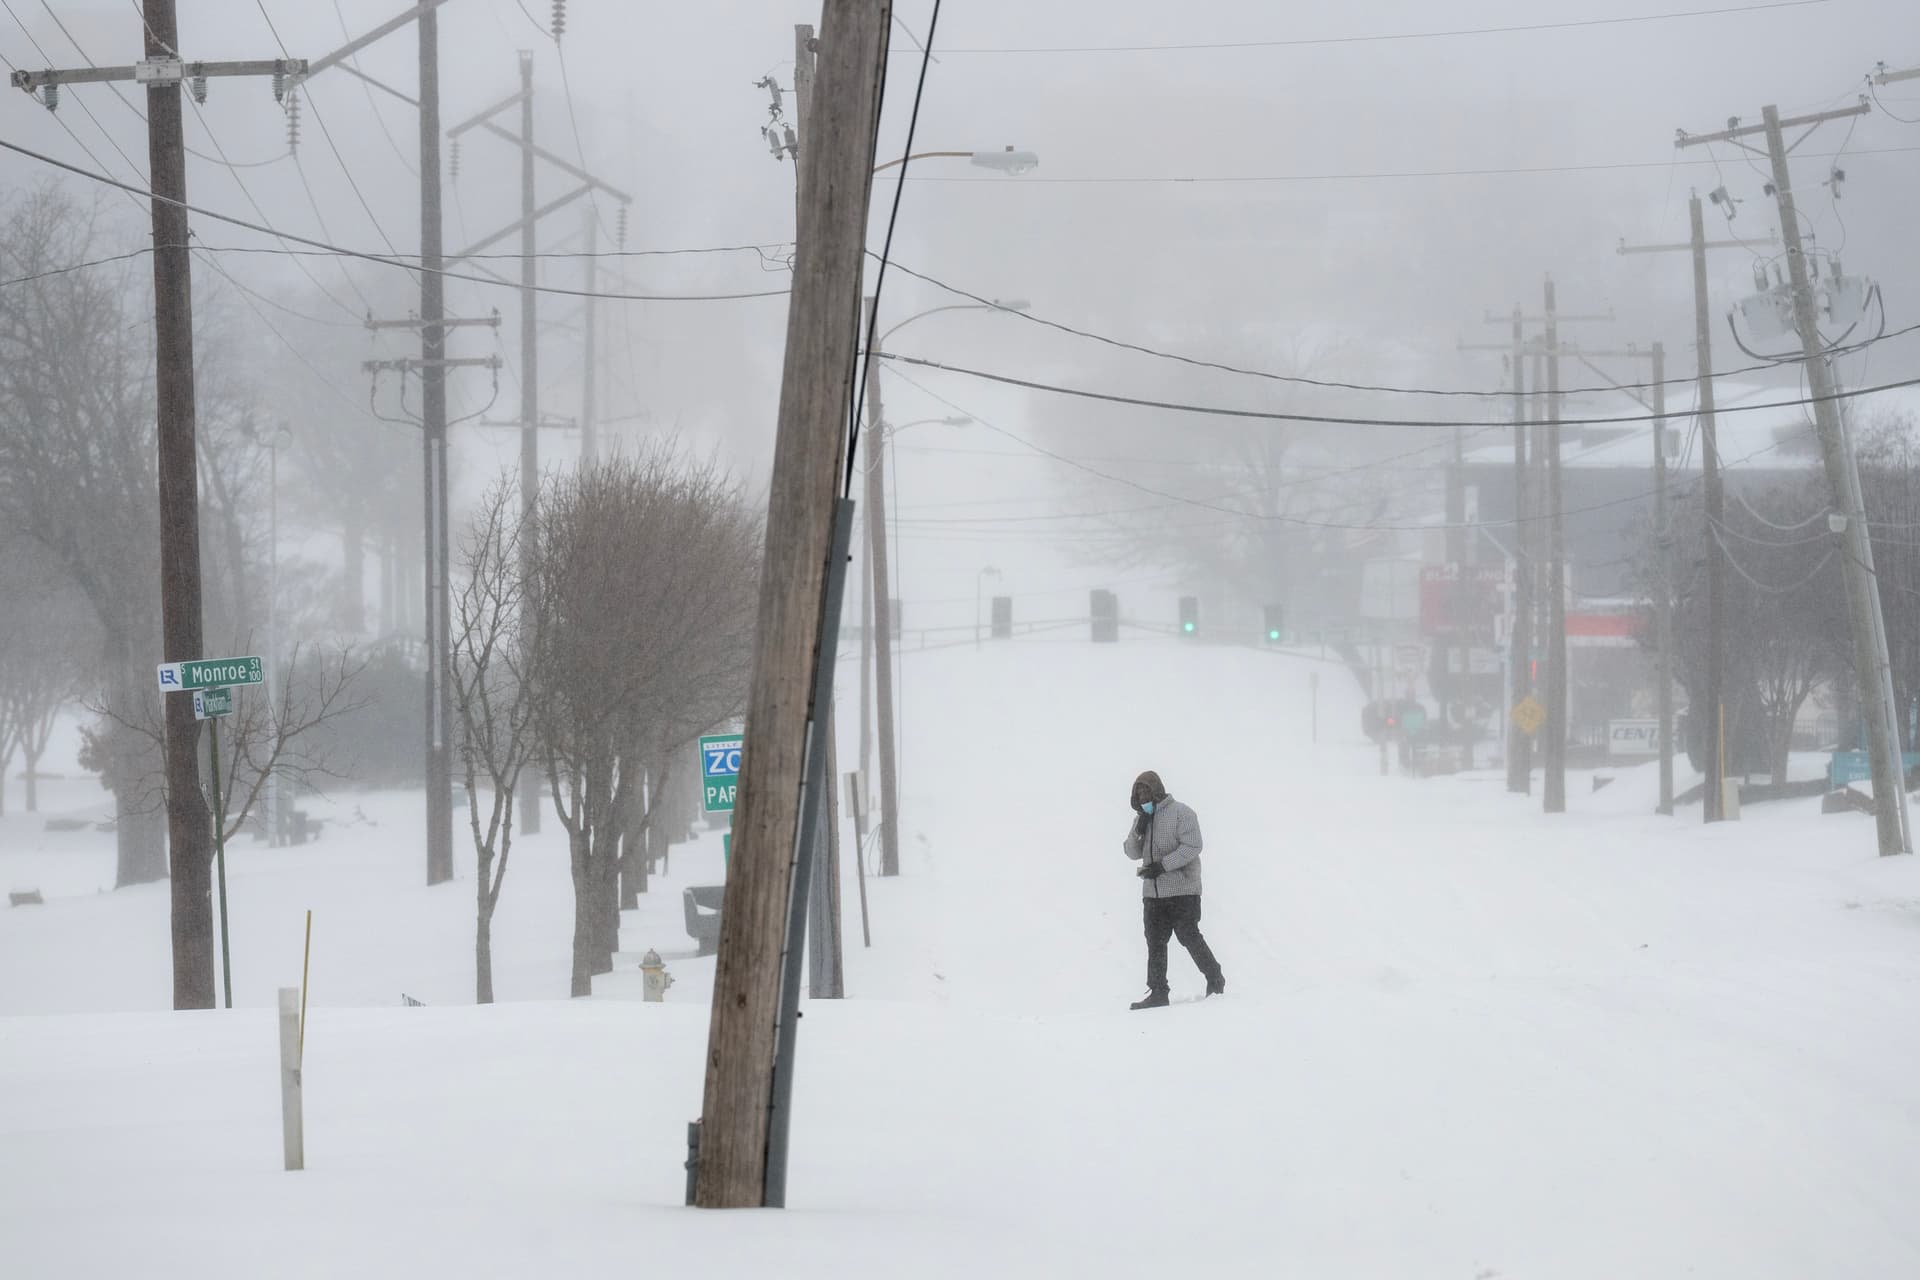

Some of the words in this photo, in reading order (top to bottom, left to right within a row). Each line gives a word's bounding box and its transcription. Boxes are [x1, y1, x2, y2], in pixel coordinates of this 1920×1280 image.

[180, 663, 186, 674] S
[192, 665, 246, 683] Monroe
[250, 658, 260, 670] St
[249, 670, 261, 681] 100
